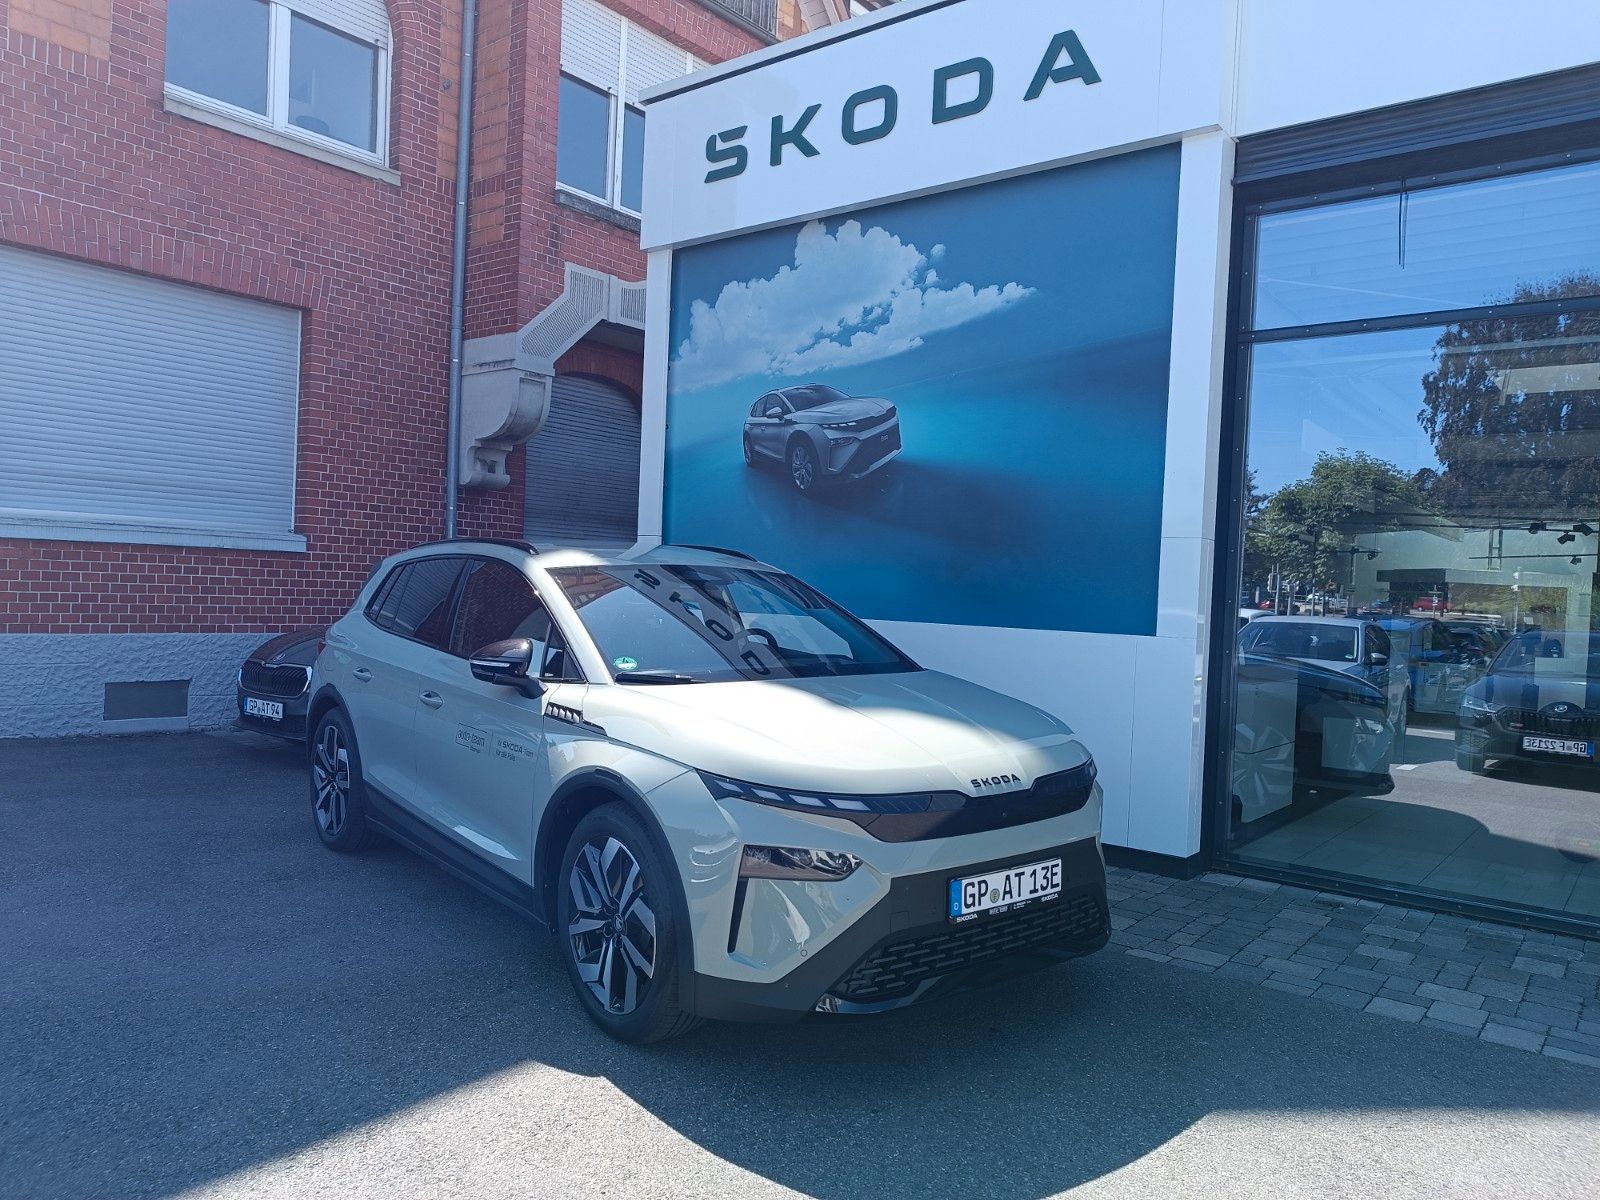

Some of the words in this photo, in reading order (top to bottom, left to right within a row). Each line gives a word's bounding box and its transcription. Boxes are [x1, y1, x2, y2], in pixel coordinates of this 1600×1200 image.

[703, 29, 1102, 184] SKODA
[249, 700, 258, 711] GP
[261, 702, 270, 714] AT
[271, 704, 280, 715] 94
[970, 773, 1021, 788] SKODA
[963, 879, 989, 910] GP
[1002, 871, 1026, 901] AT
[1029, 863, 1060, 895] 13E
[956, 913, 978, 923] SKODA
